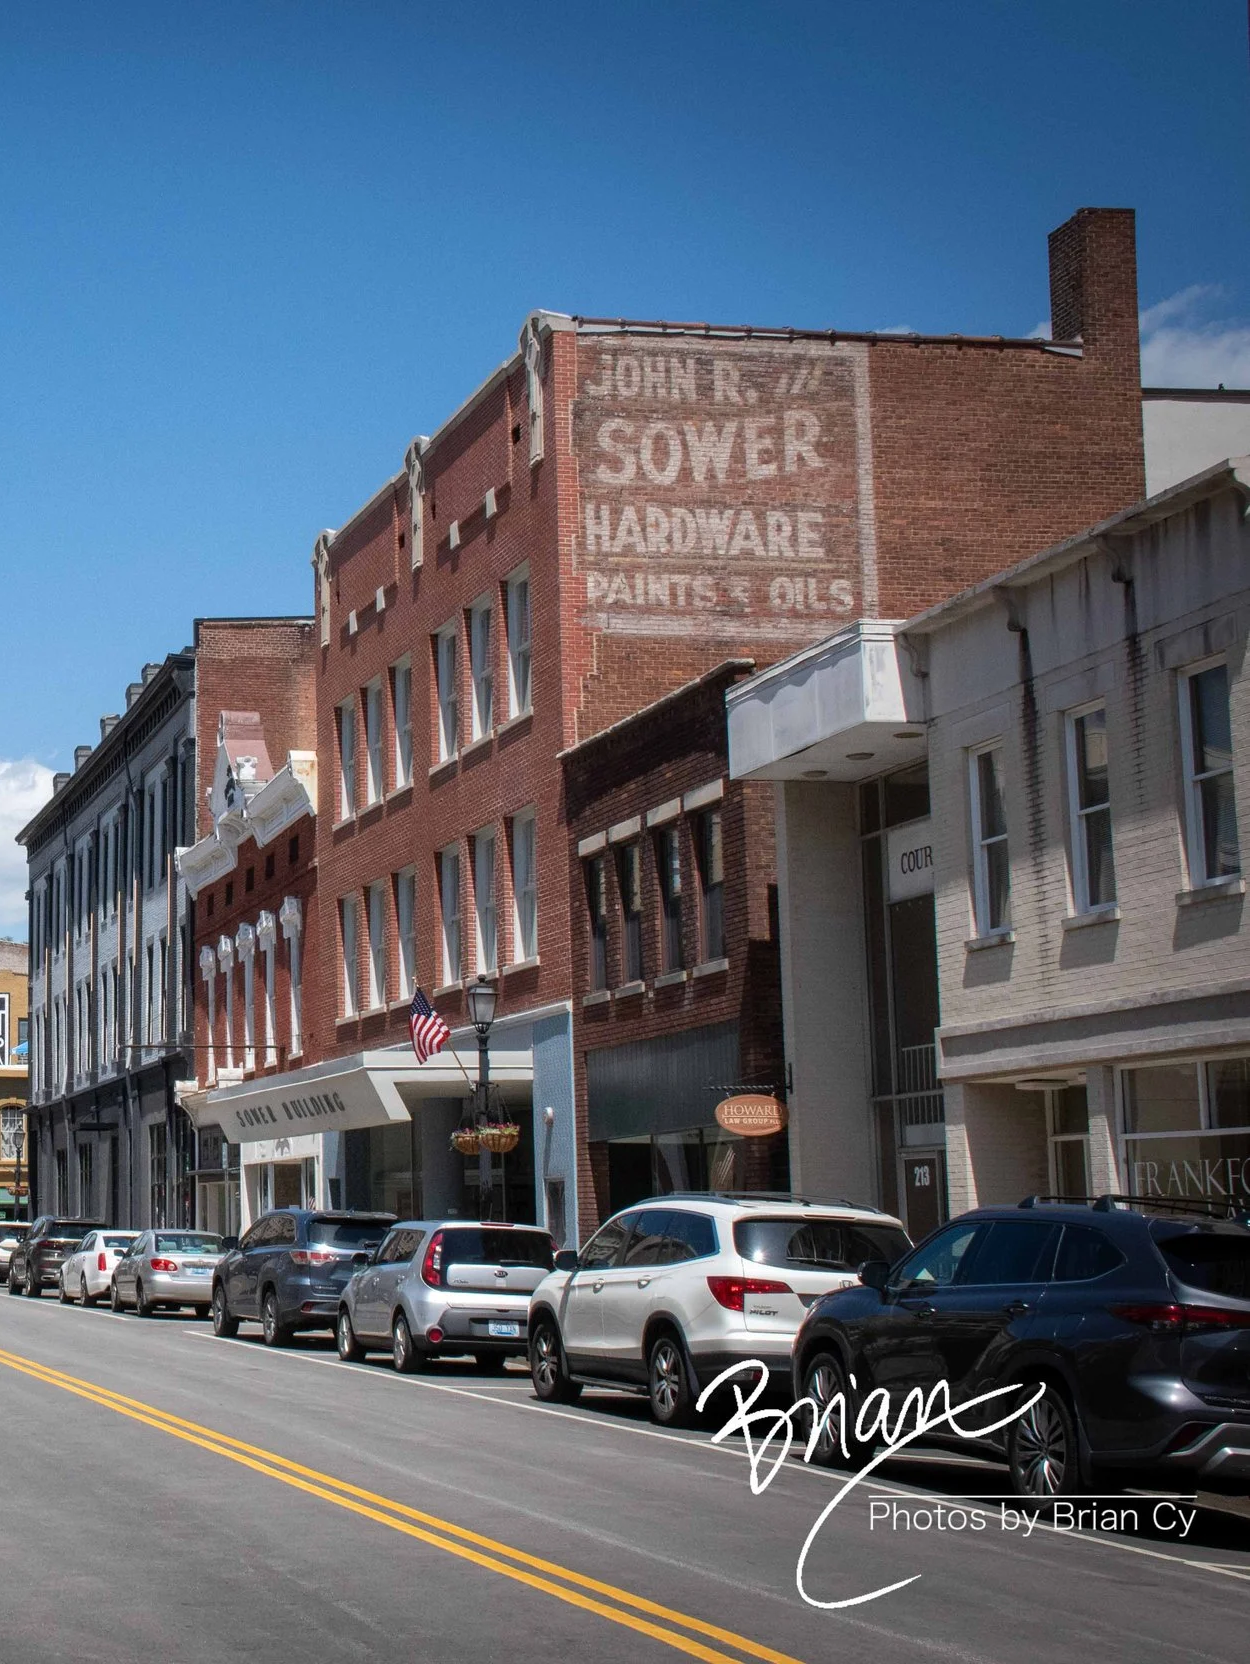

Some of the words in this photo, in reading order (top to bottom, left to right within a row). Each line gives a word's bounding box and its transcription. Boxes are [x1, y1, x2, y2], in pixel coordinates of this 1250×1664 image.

[584, 353, 697, 400] JOHN
[597, 410, 827, 486] SOWER
[585, 502, 826, 558] HARDWARE
[586, 571, 717, 610] PAINTS
[769, 576, 854, 612] OILS
[901, 845, 934, 874] COUR
[235, 1105, 278, 1128] SOWER
[281, 1091, 346, 1121] BUILDING
[723, 1104, 783, 1116] HOWARD
[914, 1166, 930, 1187] 213
